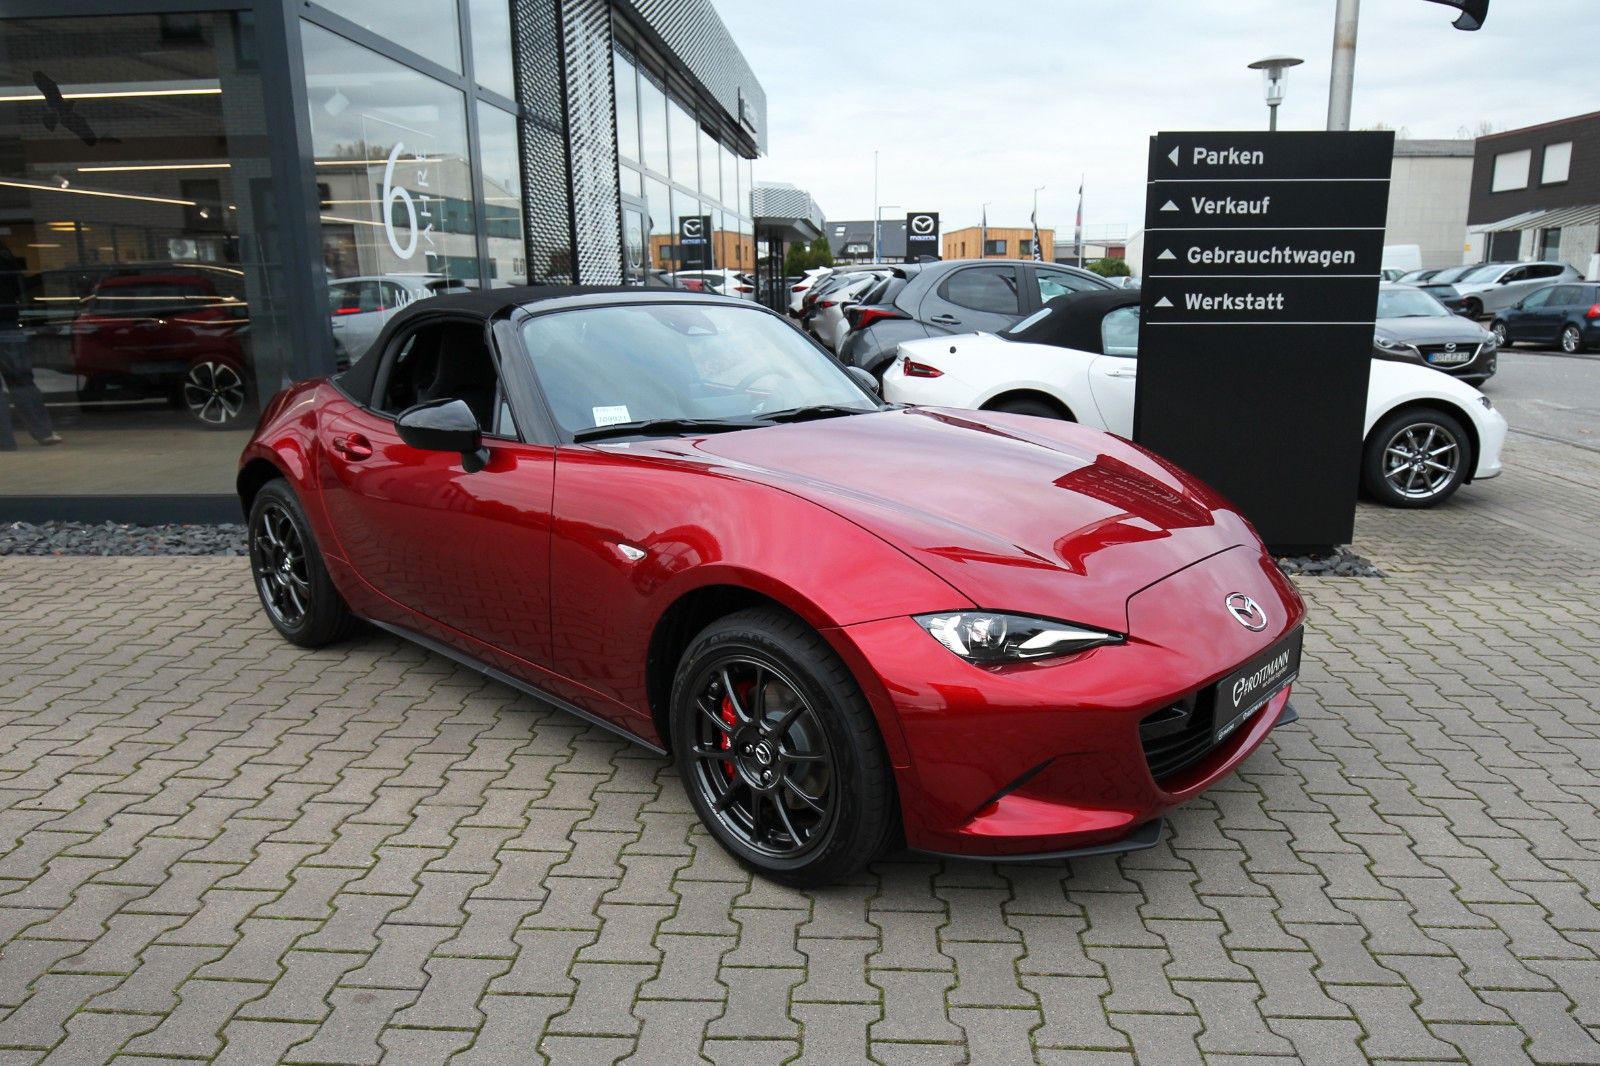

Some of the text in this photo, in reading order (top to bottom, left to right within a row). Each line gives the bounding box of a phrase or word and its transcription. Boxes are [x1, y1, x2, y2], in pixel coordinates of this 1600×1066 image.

[1193, 147, 1264, 165] Parken
[1191, 196, 1270, 214] Verkauf
[1187, 246, 1356, 267] Gebrauchtwagen
[1185, 293, 1285, 310] Werkstatt
